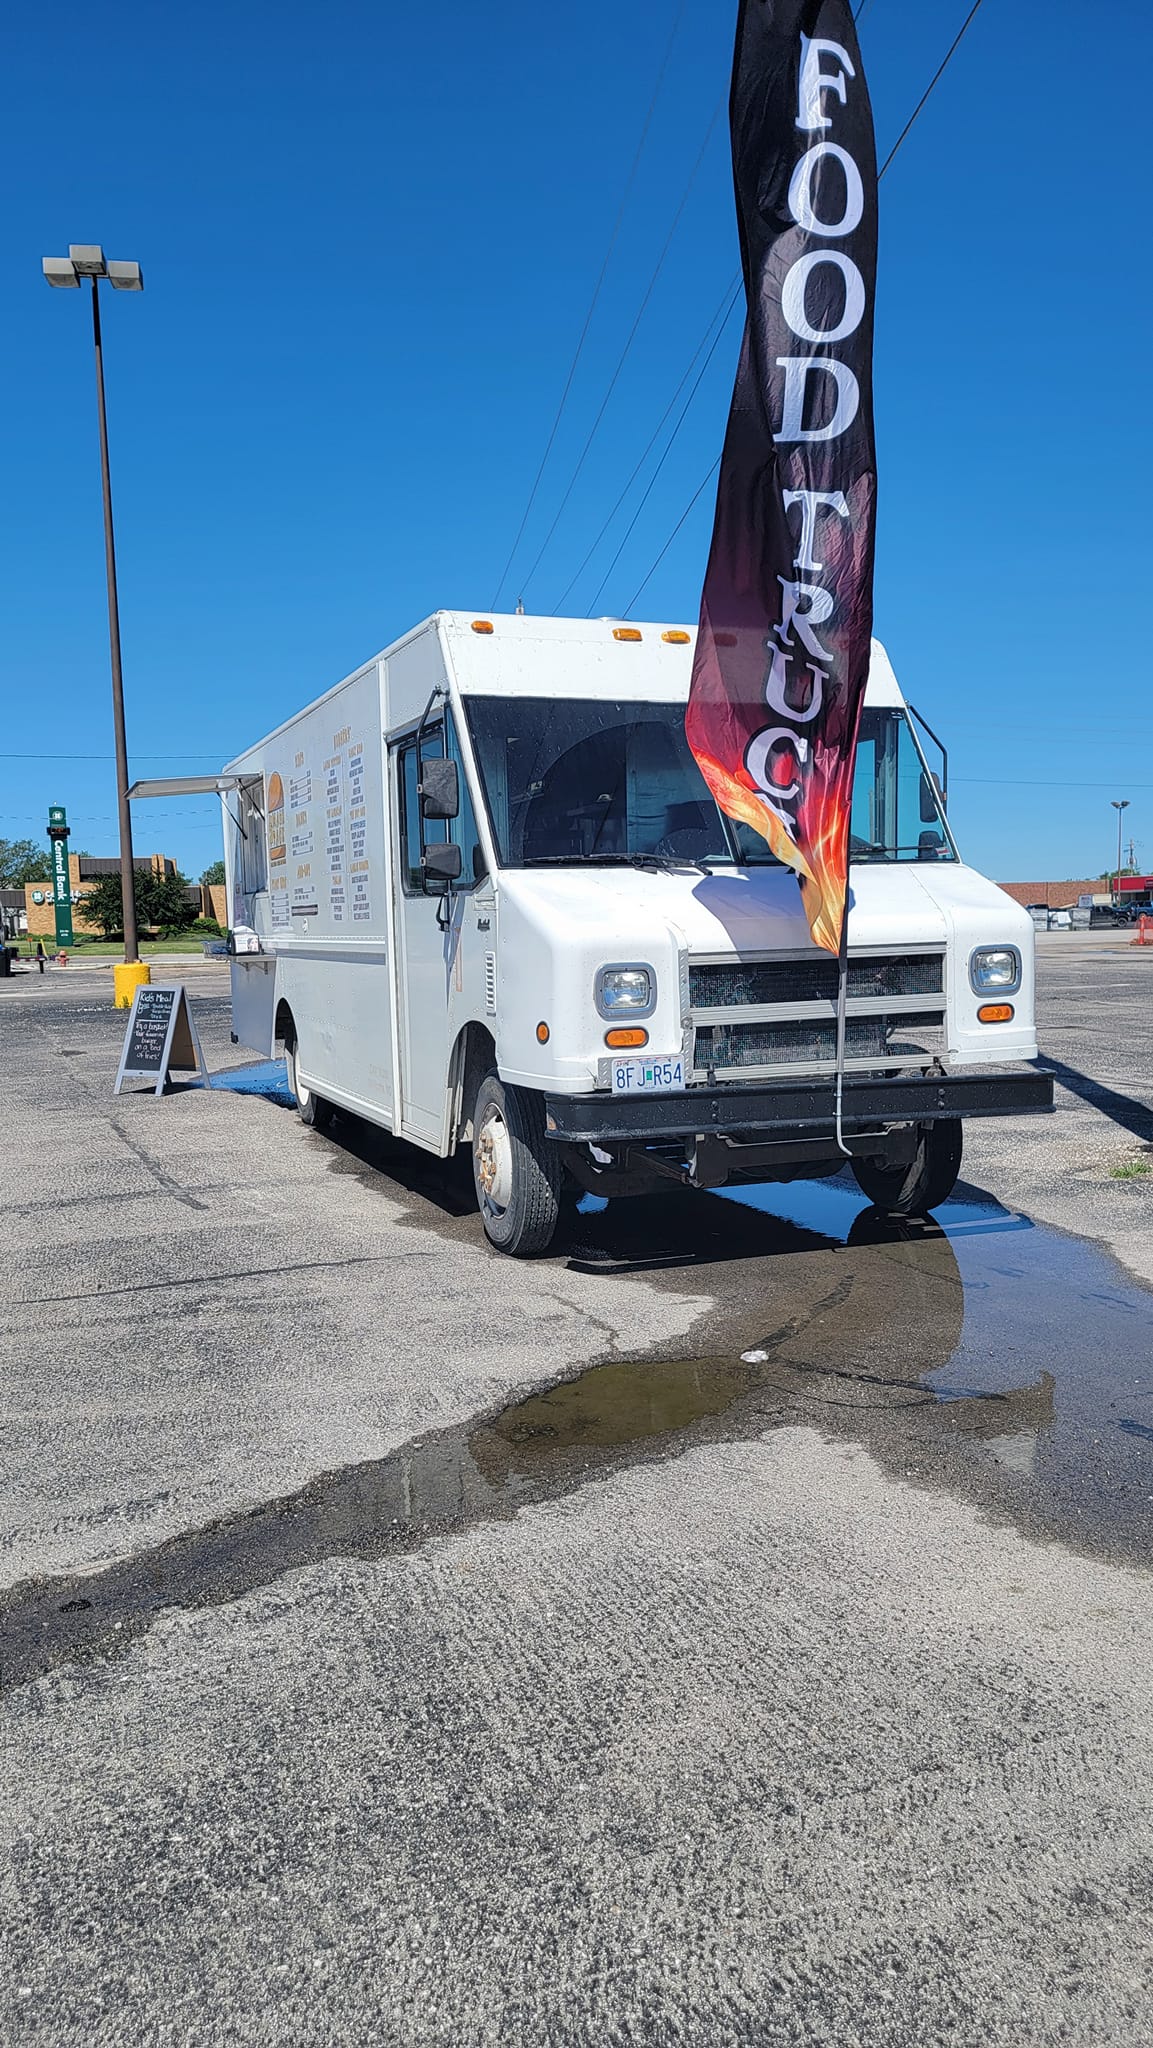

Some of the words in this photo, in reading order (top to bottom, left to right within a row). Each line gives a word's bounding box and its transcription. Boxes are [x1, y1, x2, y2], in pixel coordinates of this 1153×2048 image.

[772, 30, 865, 443] FOOD
[54, 840, 66, 874] Central
[56, 876, 68, 900] Bank
